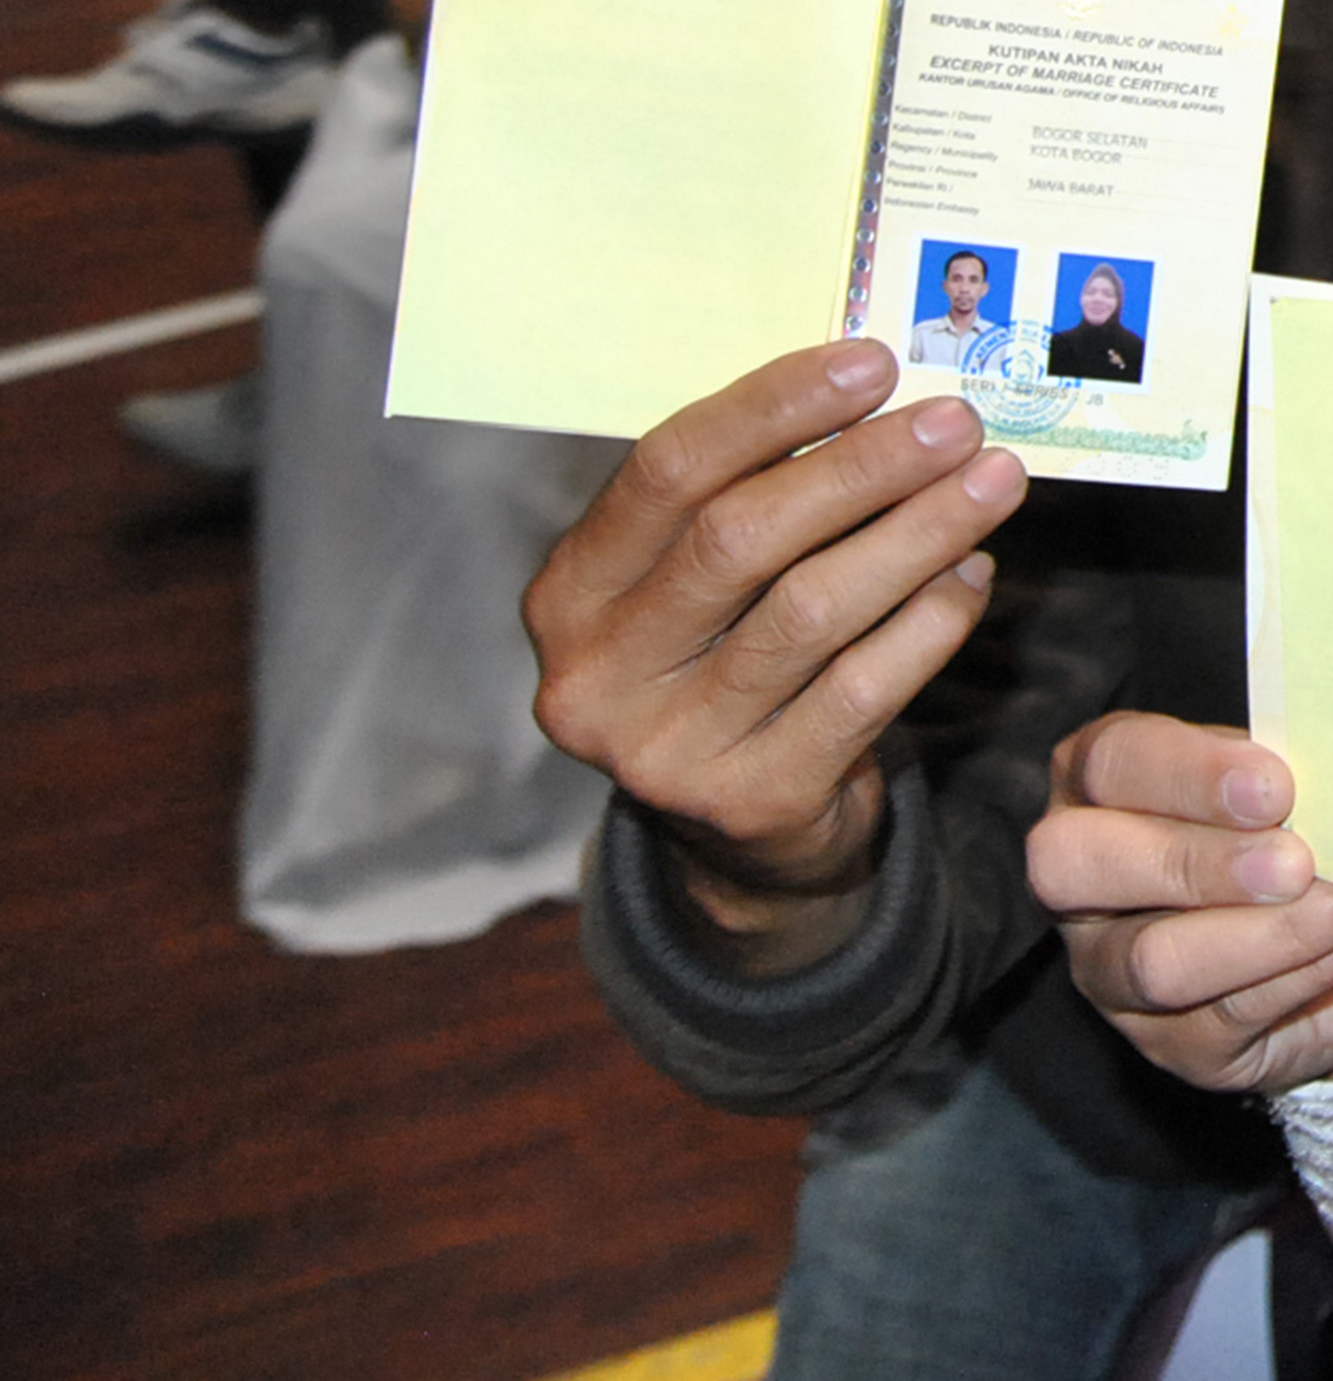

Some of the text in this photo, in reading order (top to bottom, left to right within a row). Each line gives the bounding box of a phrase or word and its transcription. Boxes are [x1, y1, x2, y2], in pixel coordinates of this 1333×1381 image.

[930, 13, 991, 31] REPUBLIK
[995, 21, 1061, 38] INDONESIA
[1072, 29, 1135, 47] REPUBLIC
[1138, 37, 1155, 49] OF
[1157, 39, 1223, 56] INDONESIA
[988, 44, 1163, 74] KUTIPAN AKTA NIKAH
[930, 55, 1219, 98] EXCERPT OF MARRIAGE CERTIFICATE
[918, 73, 965, 85] KANTOR
[967, 78, 1013, 91] URUSAN
[1014, 83, 1054, 95] AGAMA
[1062, 88, 1101, 100] OFFICE
[1104, 93, 1118, 102] OF
[1121, 95, 1178, 109] RELIGIOUS
[1180, 101, 1225, 115] AFFAIRS
[1032, 125, 1148, 149] BOGOR SELATAN
[1030, 144, 1122, 165] KOTA BOGOR
[1027, 178, 1114, 197] JAWA BARAT
